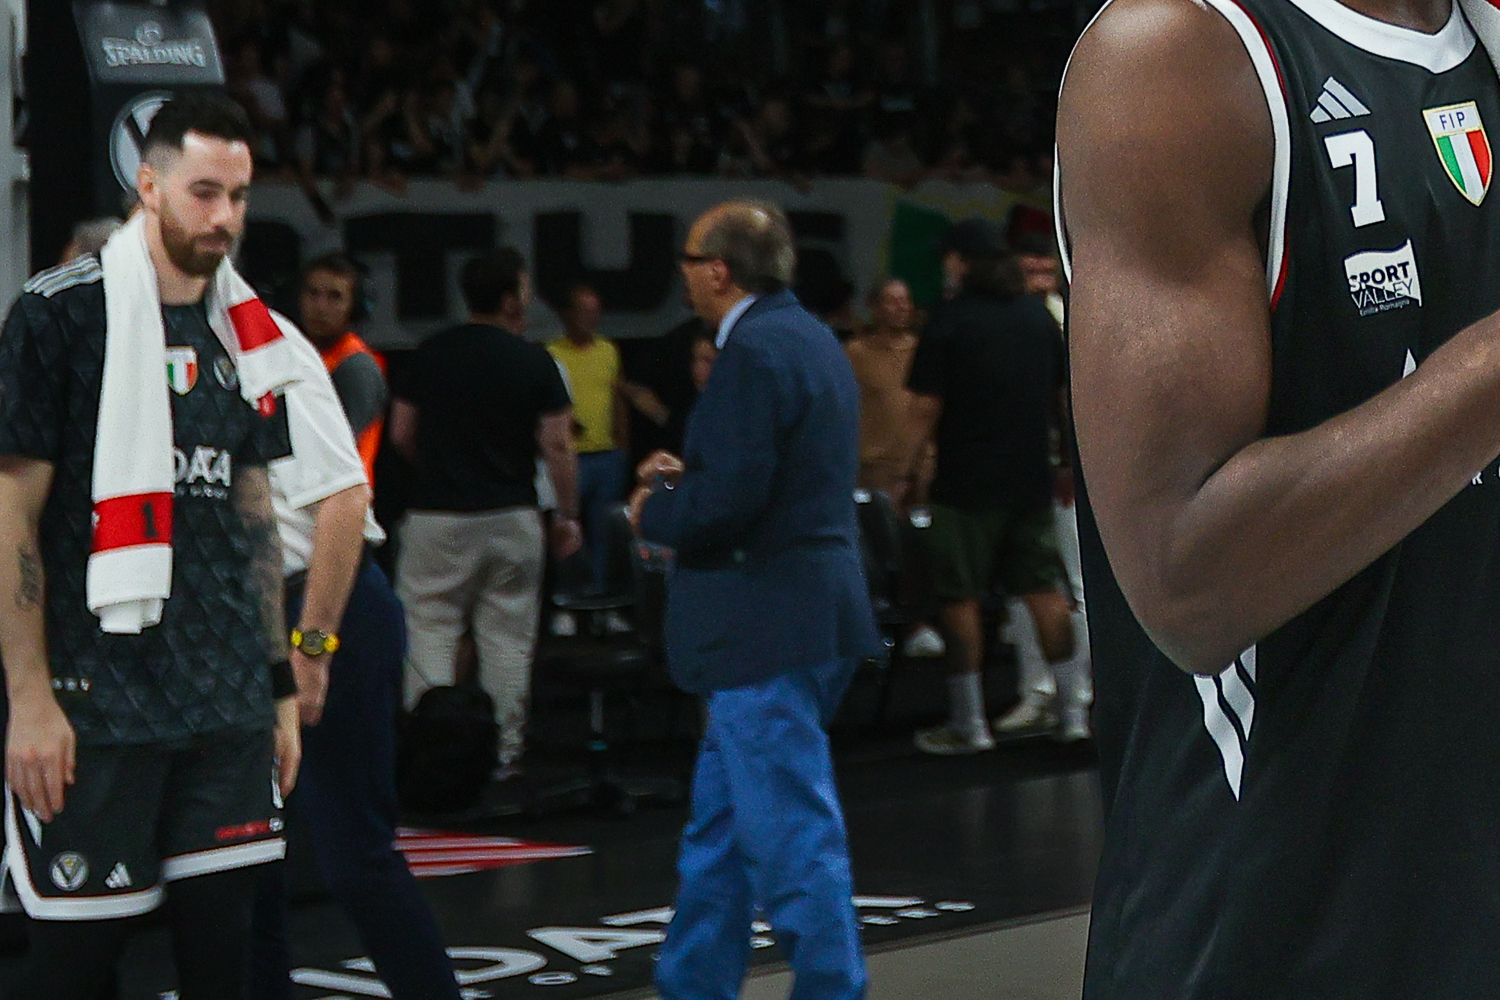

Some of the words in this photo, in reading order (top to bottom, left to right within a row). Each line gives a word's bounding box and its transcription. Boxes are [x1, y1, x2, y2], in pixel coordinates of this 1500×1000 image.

[103, 37, 206, 68] SPALDING
[1438, 111, 1466, 130] FIP
[1323, 130, 1386, 228] 7
[1349, 262, 1409, 292] SPORT
[1351, 278, 1412, 309] VALLEY
